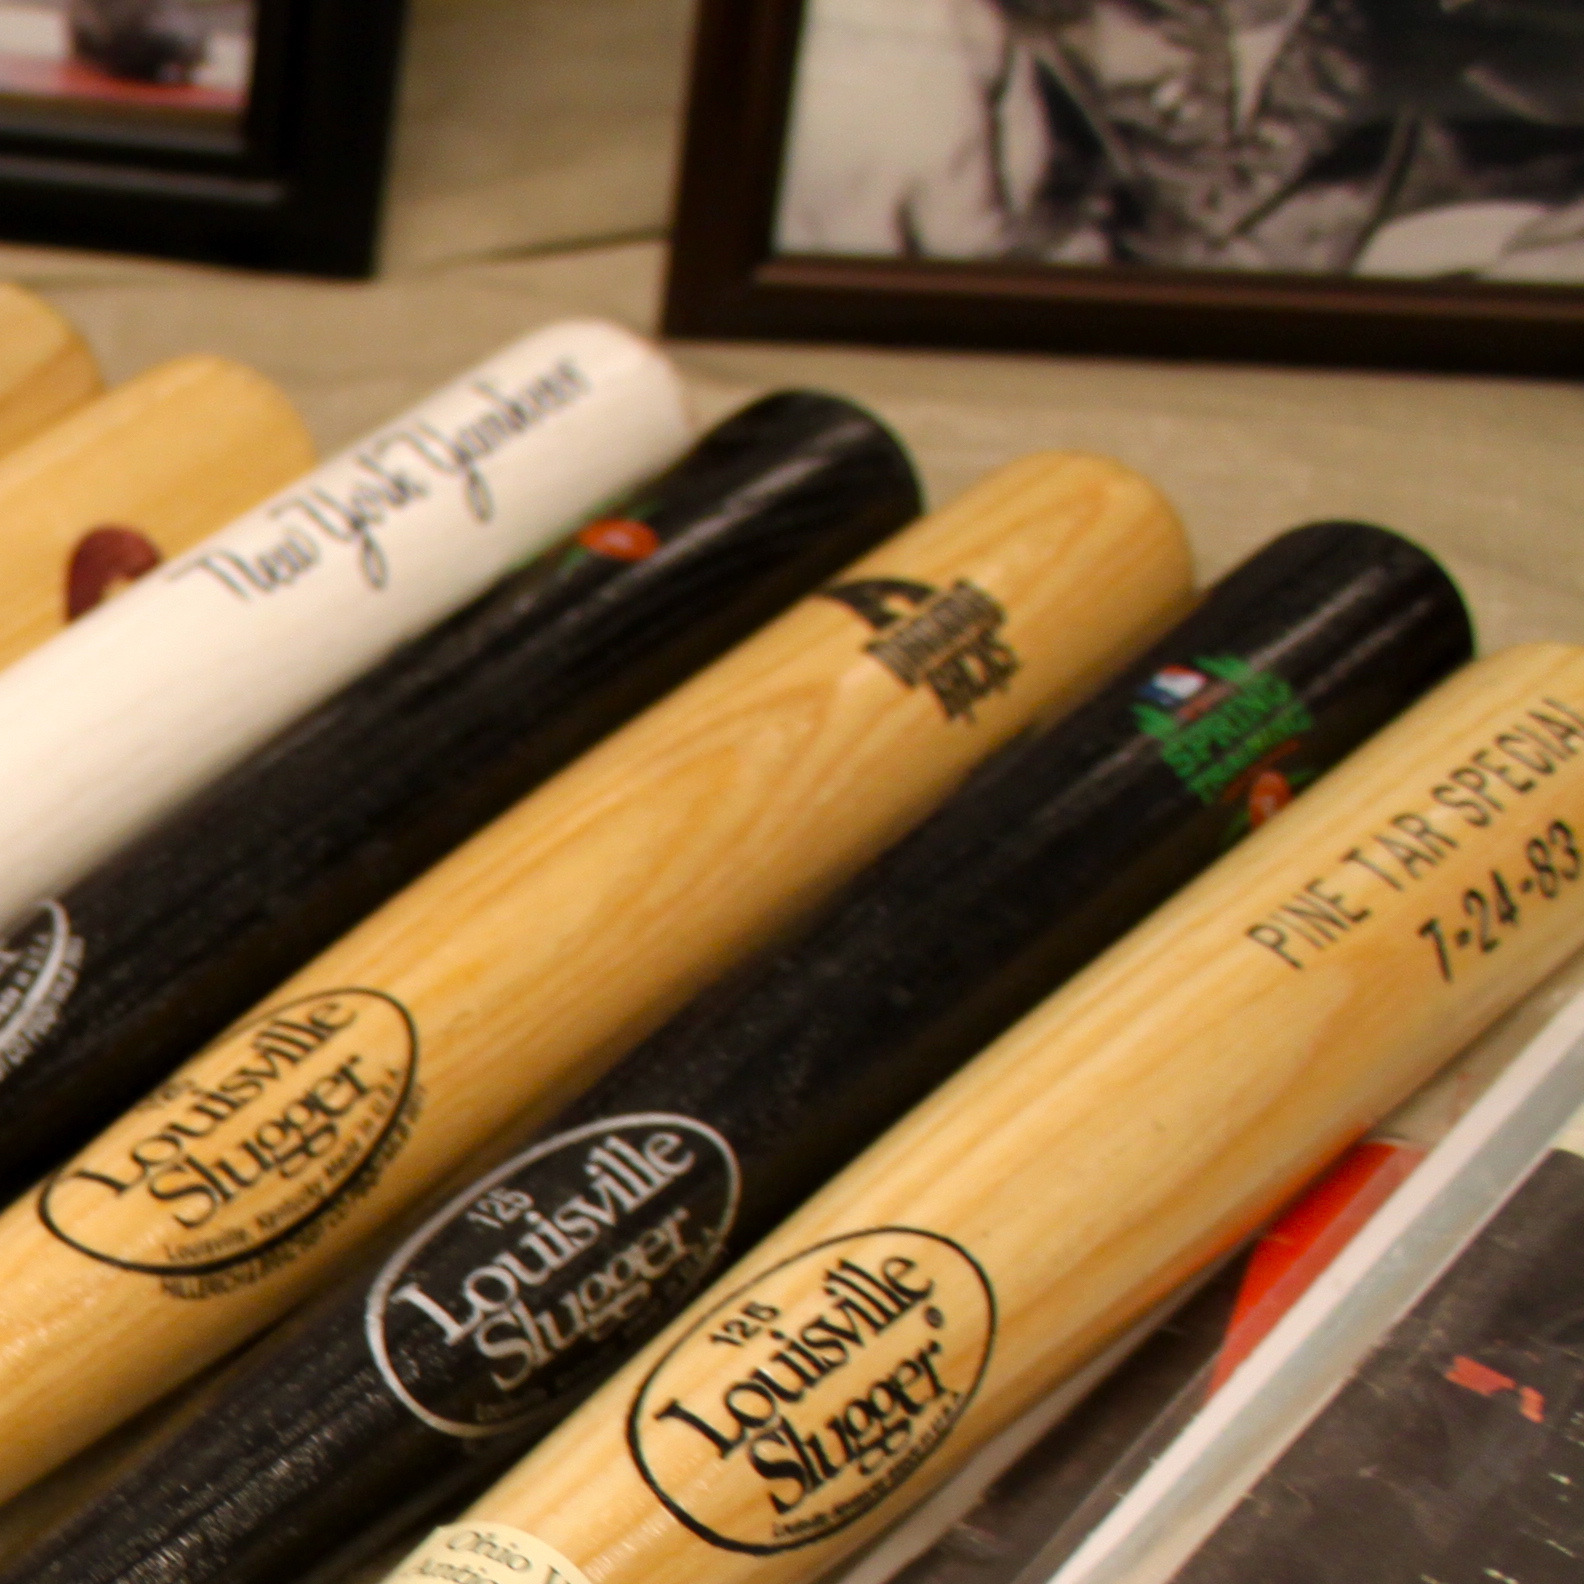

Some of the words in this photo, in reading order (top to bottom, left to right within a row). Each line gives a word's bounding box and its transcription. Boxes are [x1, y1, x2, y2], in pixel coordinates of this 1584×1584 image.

[169, 528, 320, 600] New
[269, 449, 430, 590] York
[1247, 878, 1371, 970] PINE
[1341, 811, 1460, 893] TAR
[1418, 820, 1584, 983] 7-24-83
[69, 994, 359, 1197] Louisville
[149, 1050, 372, 1233] Slugger
[388, 1121, 700, 1349] Louisville
[466, 1182, 535, 1229] 125
[469, 1207, 689, 1394] Slugger
[650, 1243, 937, 1461] Louisville
[706, 1296, 783, 1349] 125
[743, 1339, 946, 1514] Slugger
[446, 1530, 533, 1575] Ohio
